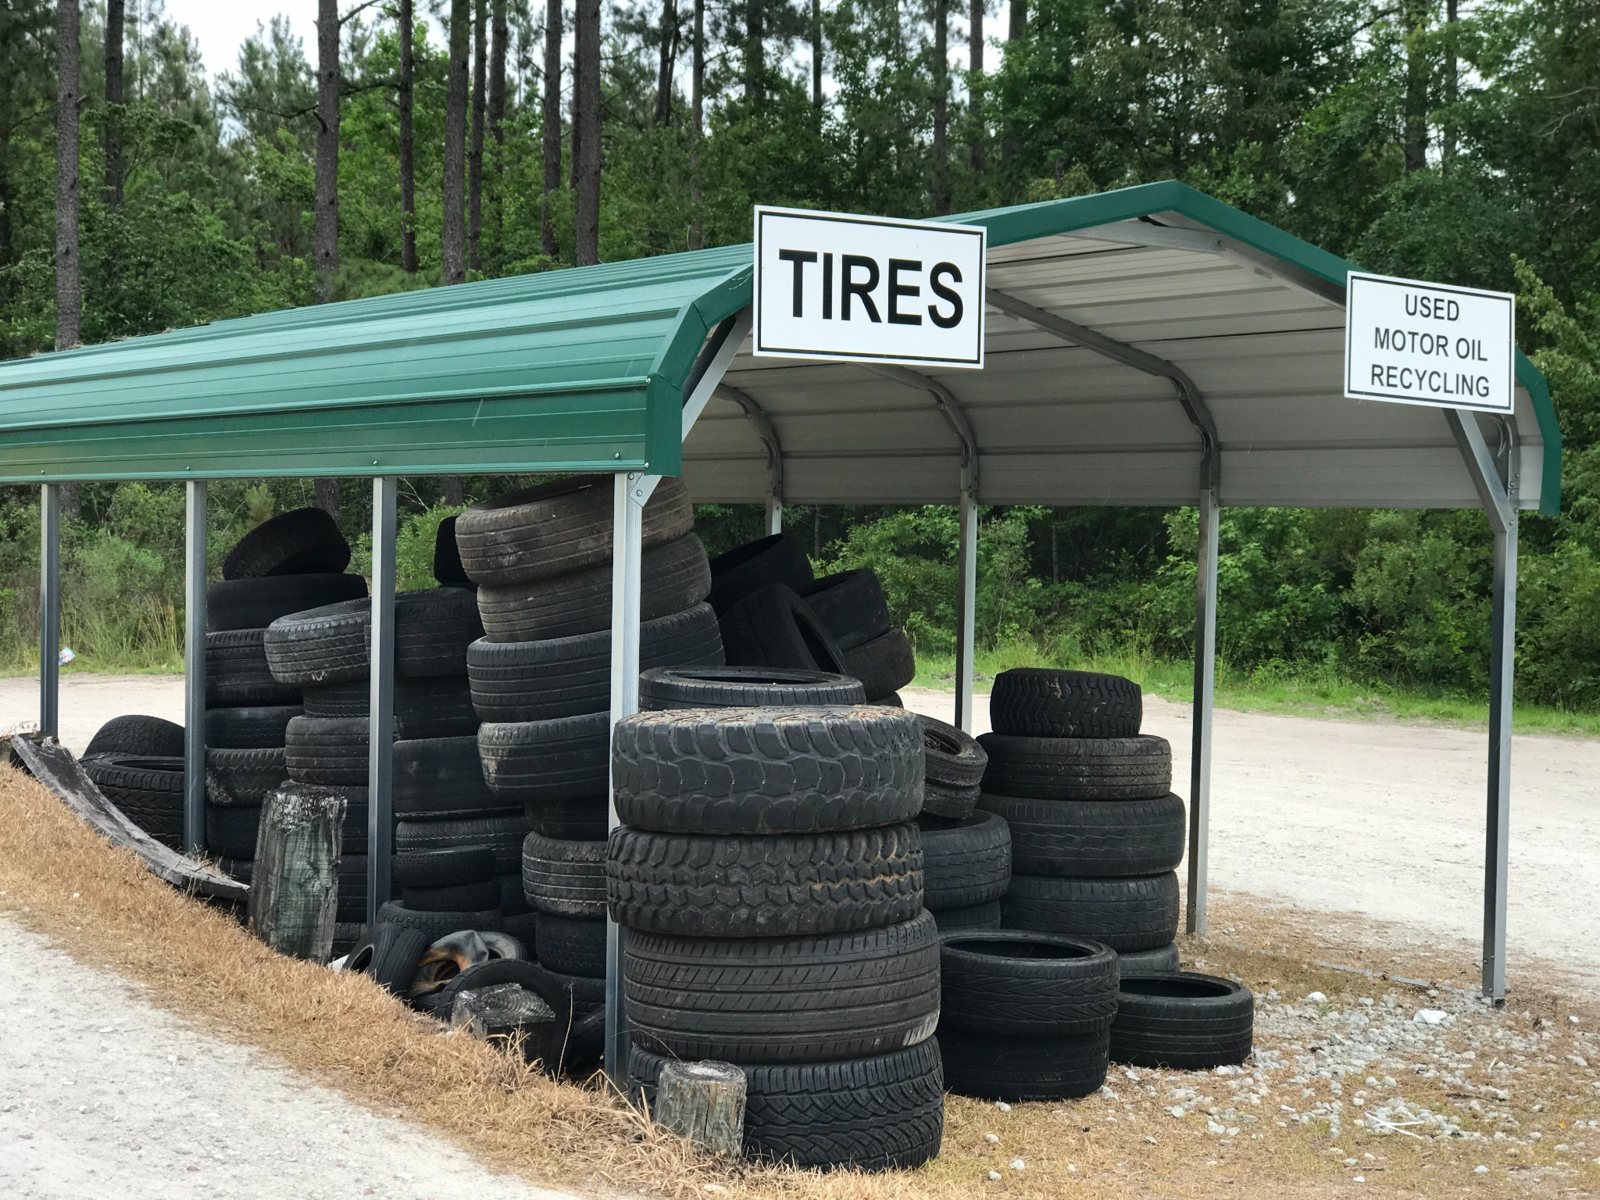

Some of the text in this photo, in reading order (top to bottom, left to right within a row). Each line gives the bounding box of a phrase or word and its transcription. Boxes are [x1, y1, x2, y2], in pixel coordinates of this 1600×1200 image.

[778, 247, 964, 329] TIRES
[1405, 293, 1460, 322] USED
[1374, 326, 1489, 362] MOTOR OIL
[1371, 363, 1490, 398] RECYCLING
